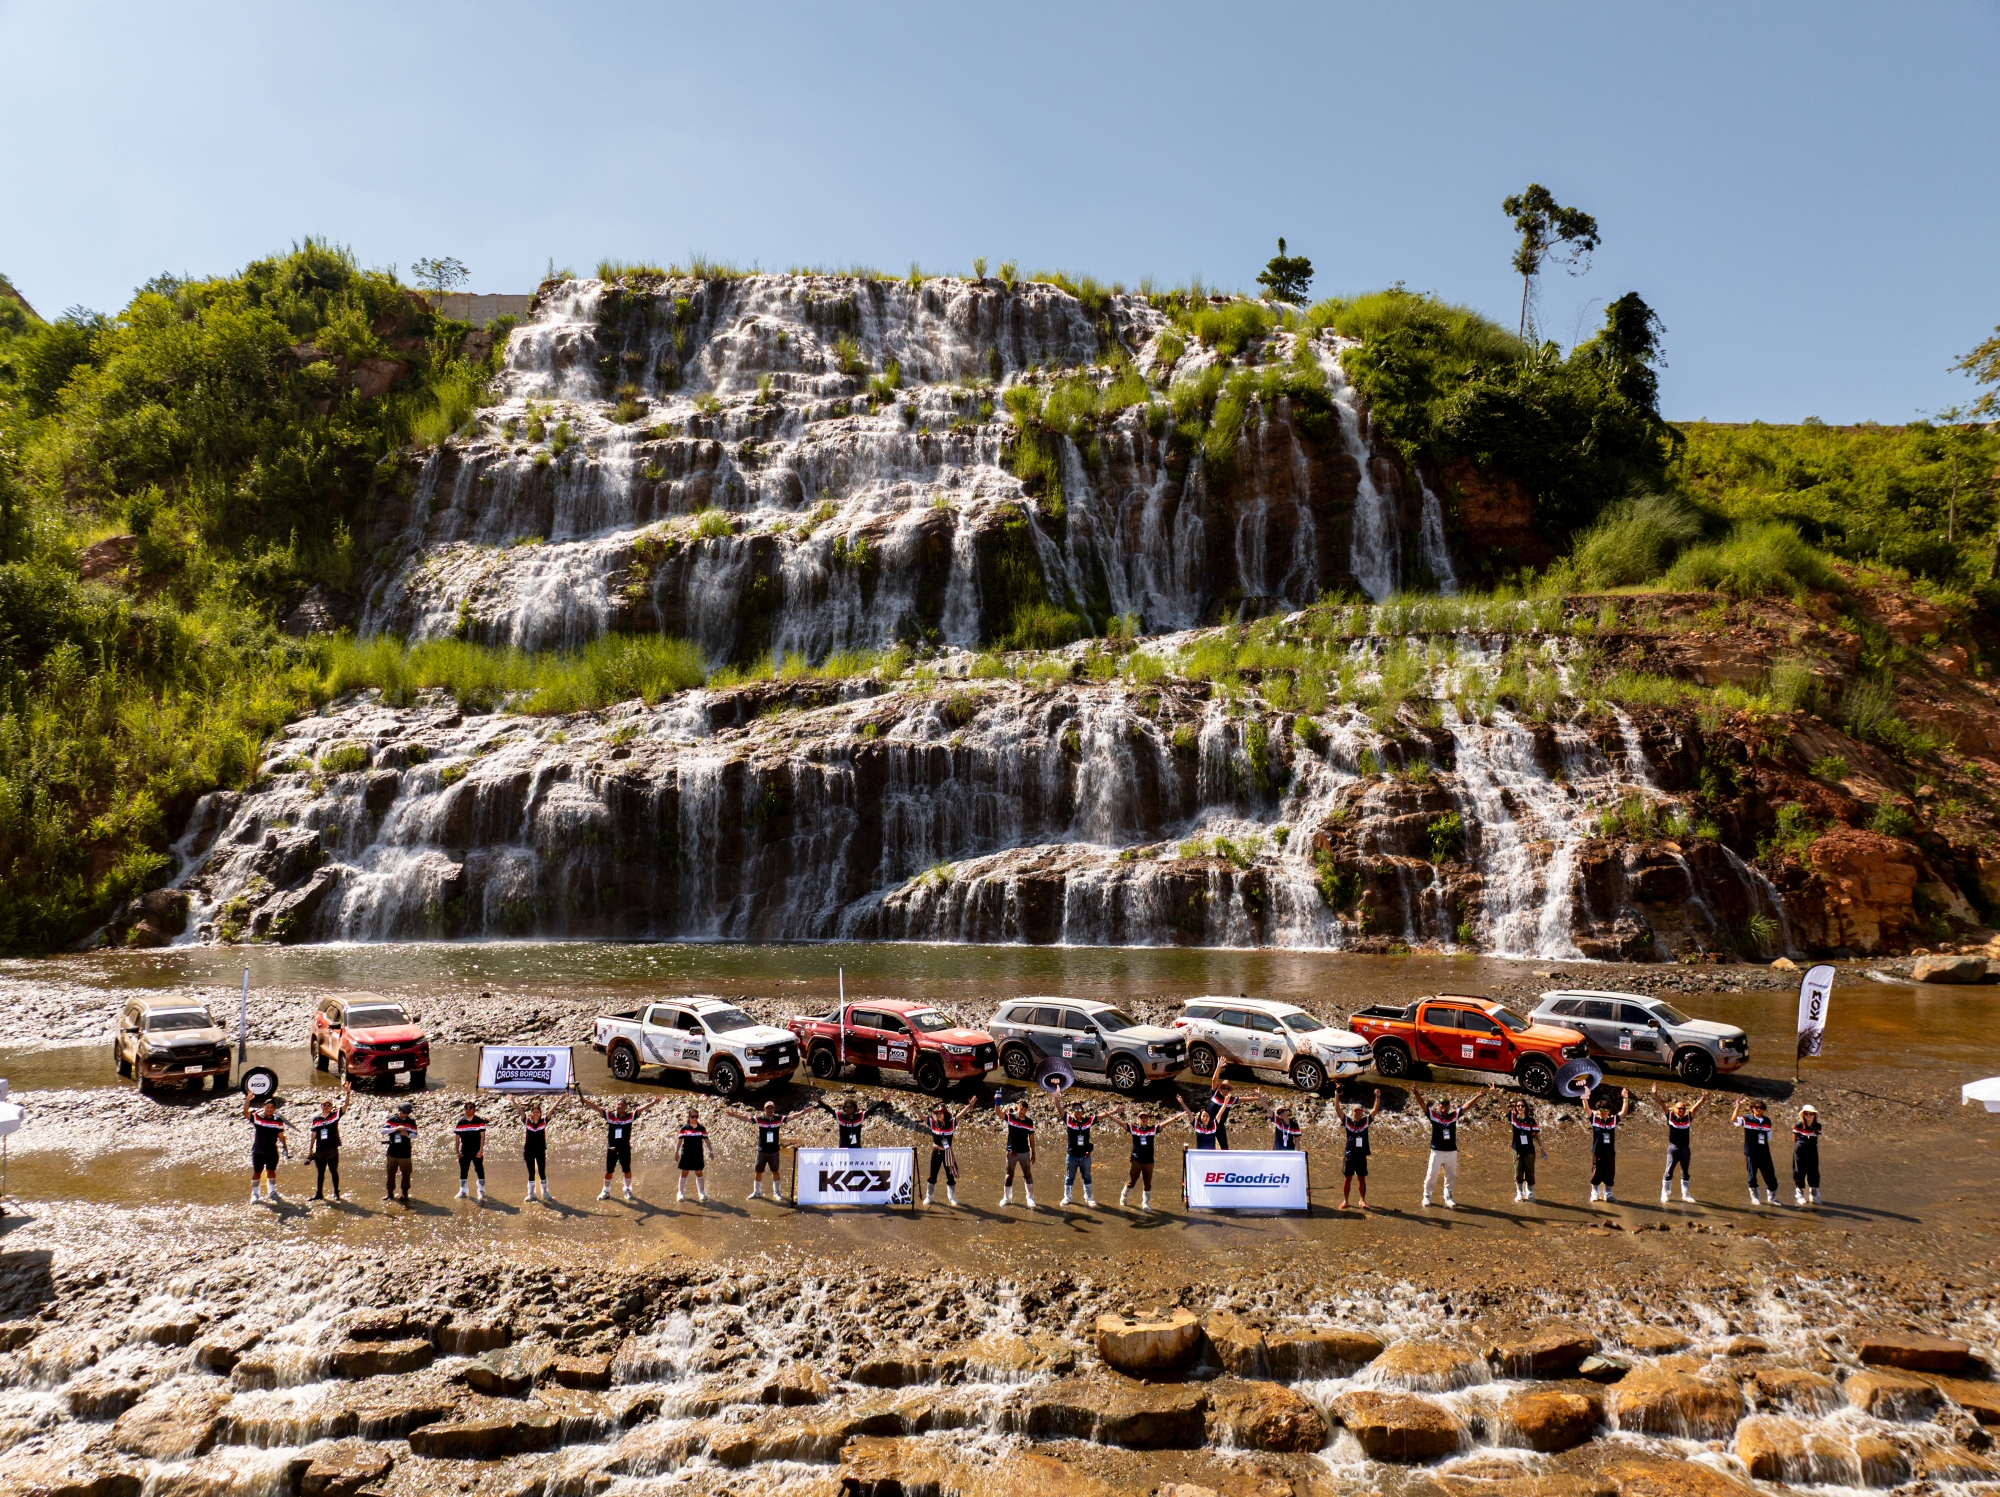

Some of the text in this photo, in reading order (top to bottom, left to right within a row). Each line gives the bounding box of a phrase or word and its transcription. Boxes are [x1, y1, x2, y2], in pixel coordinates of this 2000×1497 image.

[1809, 990, 1822, 1021] KO3
[503, 1056, 547, 1069] KO3
[497, 1071, 550, 1080] CROSS BORDERS
[819, 1170, 891, 1192] KO3
[1205, 1173, 1290, 1184] BFGoodrich
